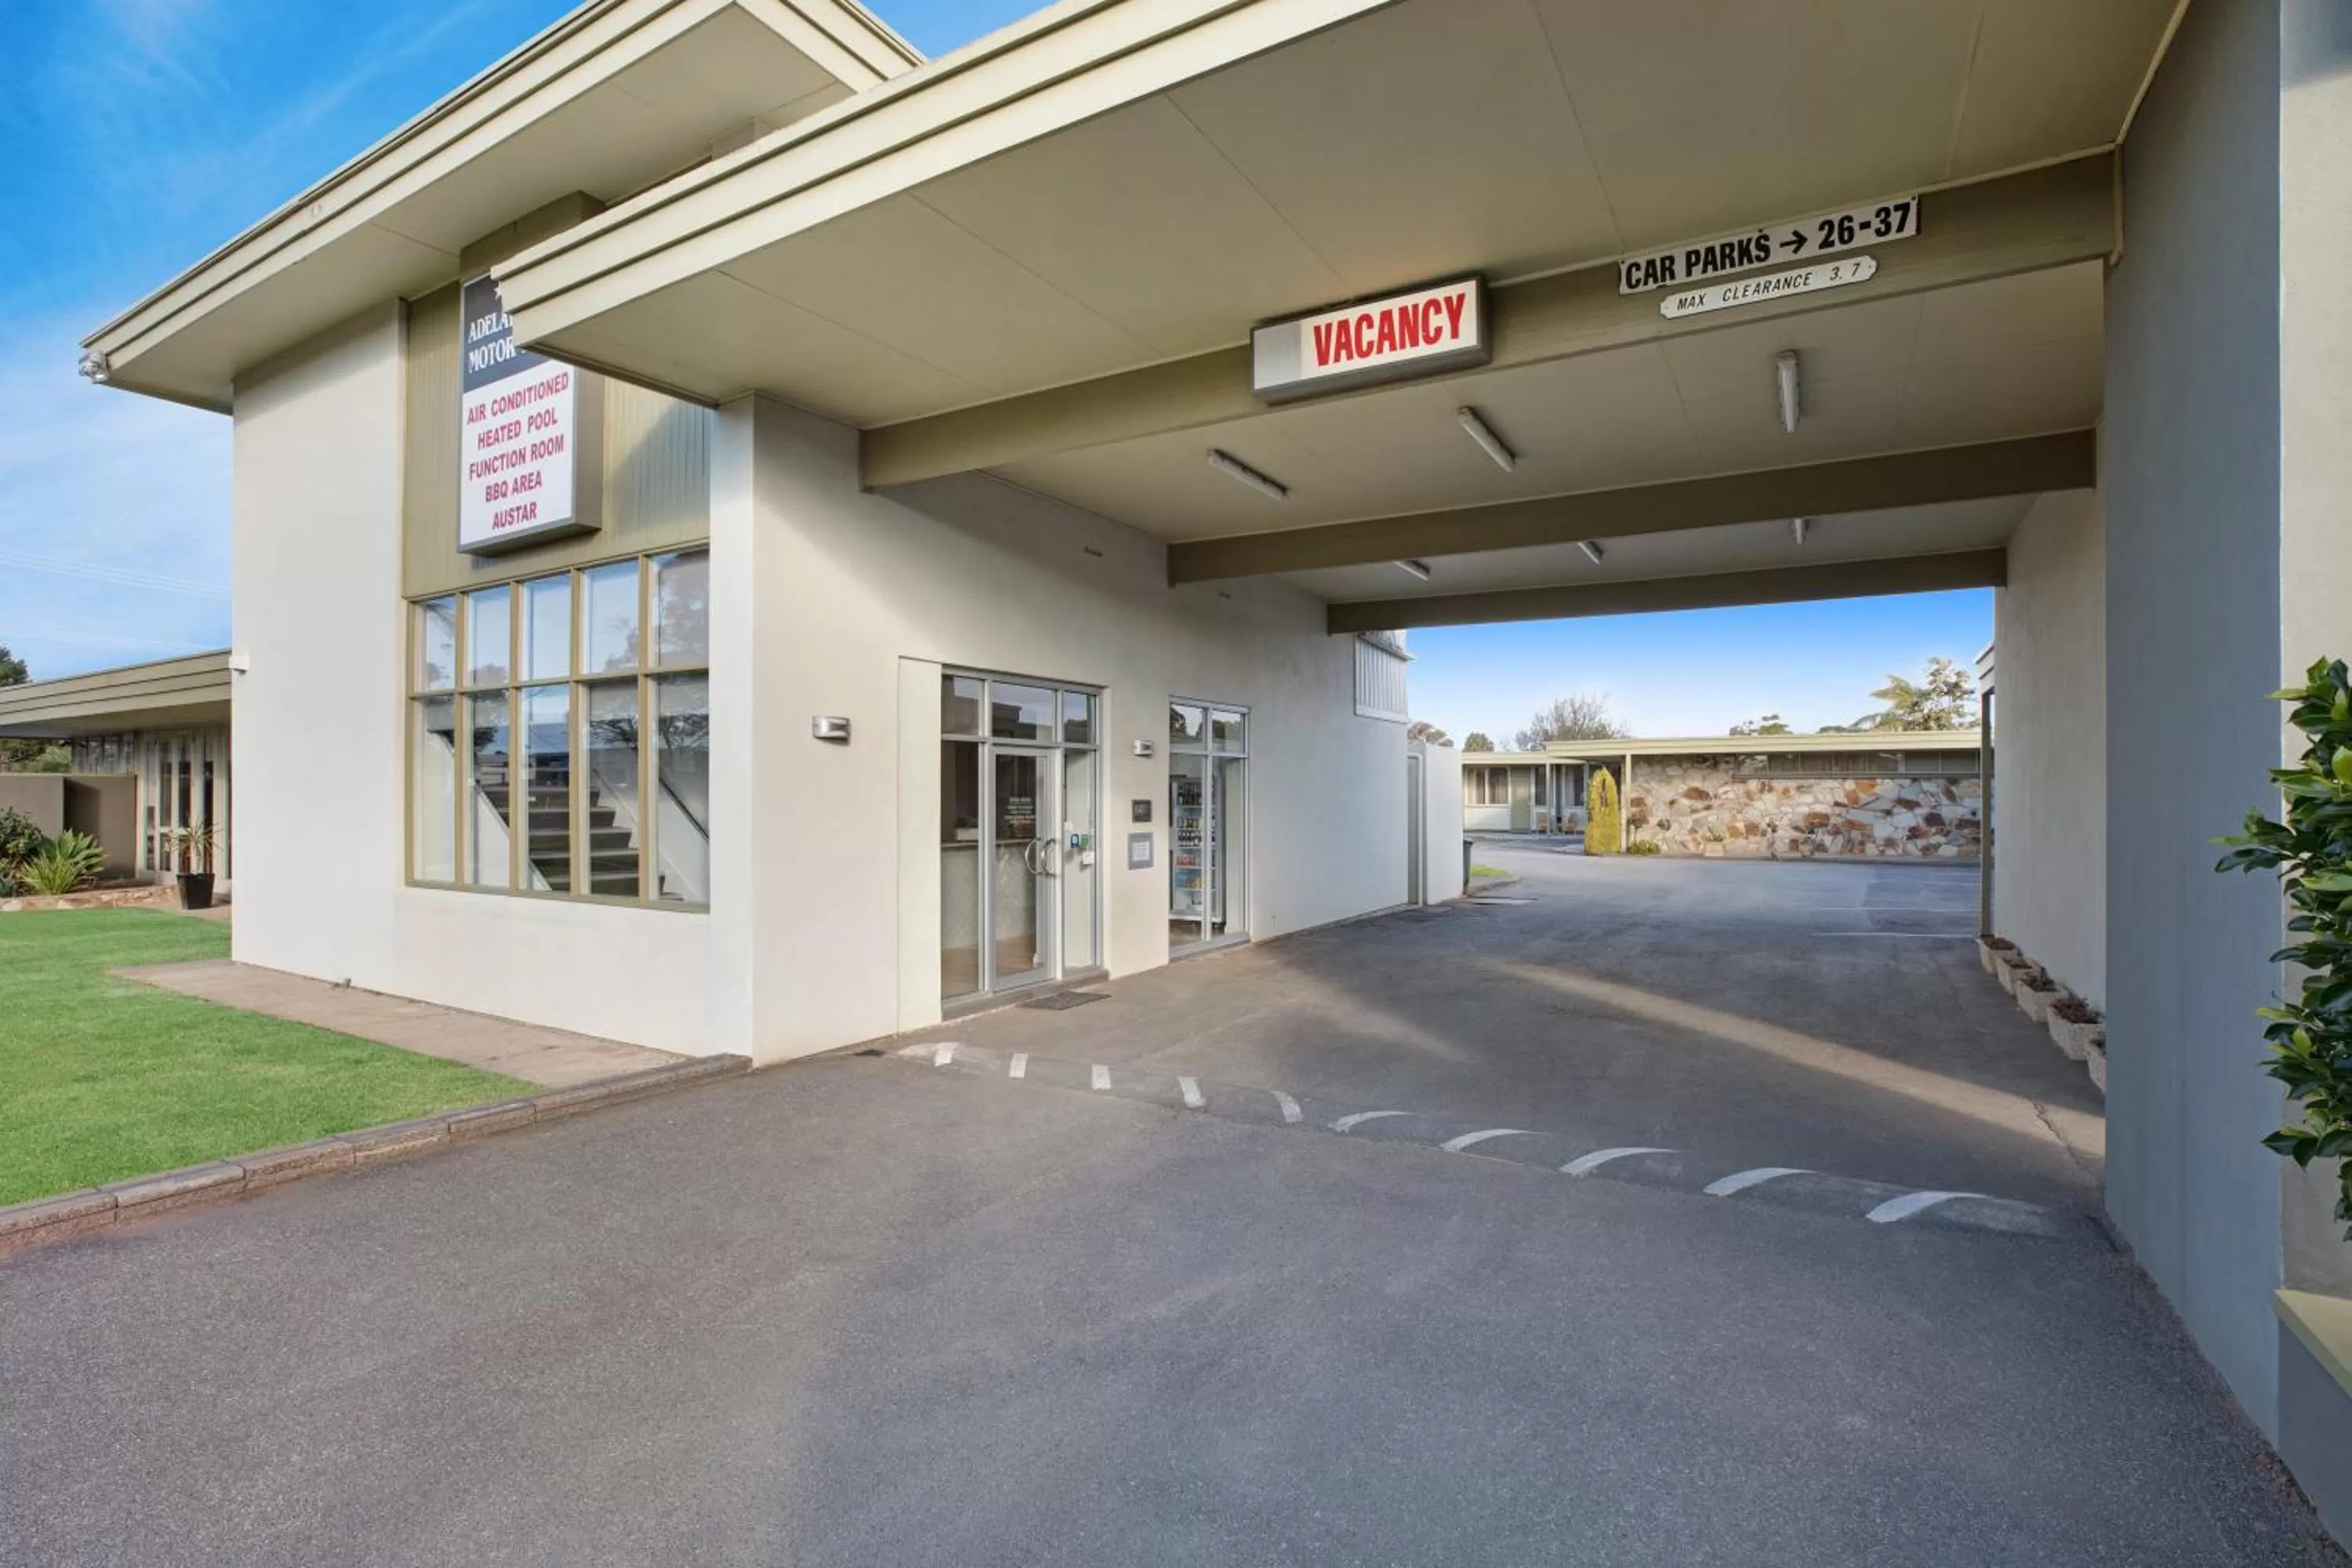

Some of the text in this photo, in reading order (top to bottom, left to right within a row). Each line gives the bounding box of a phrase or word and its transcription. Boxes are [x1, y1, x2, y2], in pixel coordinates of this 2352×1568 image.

[1625, 201, 1911, 289] CAR PARKS 26-37
[1677, 292, 1706, 310] MAX
[1722, 272, 1813, 302] CLEARANCE
[1313, 292, 1466, 366] VACANCY
[468, 336, 516, 373] MOTOR
[467, 372, 568, 424] AIR CONDITIONED
[477, 407, 558, 450] HEATED POOL
[469, 434, 564, 481] FUNCTION ROOM
[486, 470, 543, 502] BBQ AREA
[492, 502, 537, 530] AUSTAR
